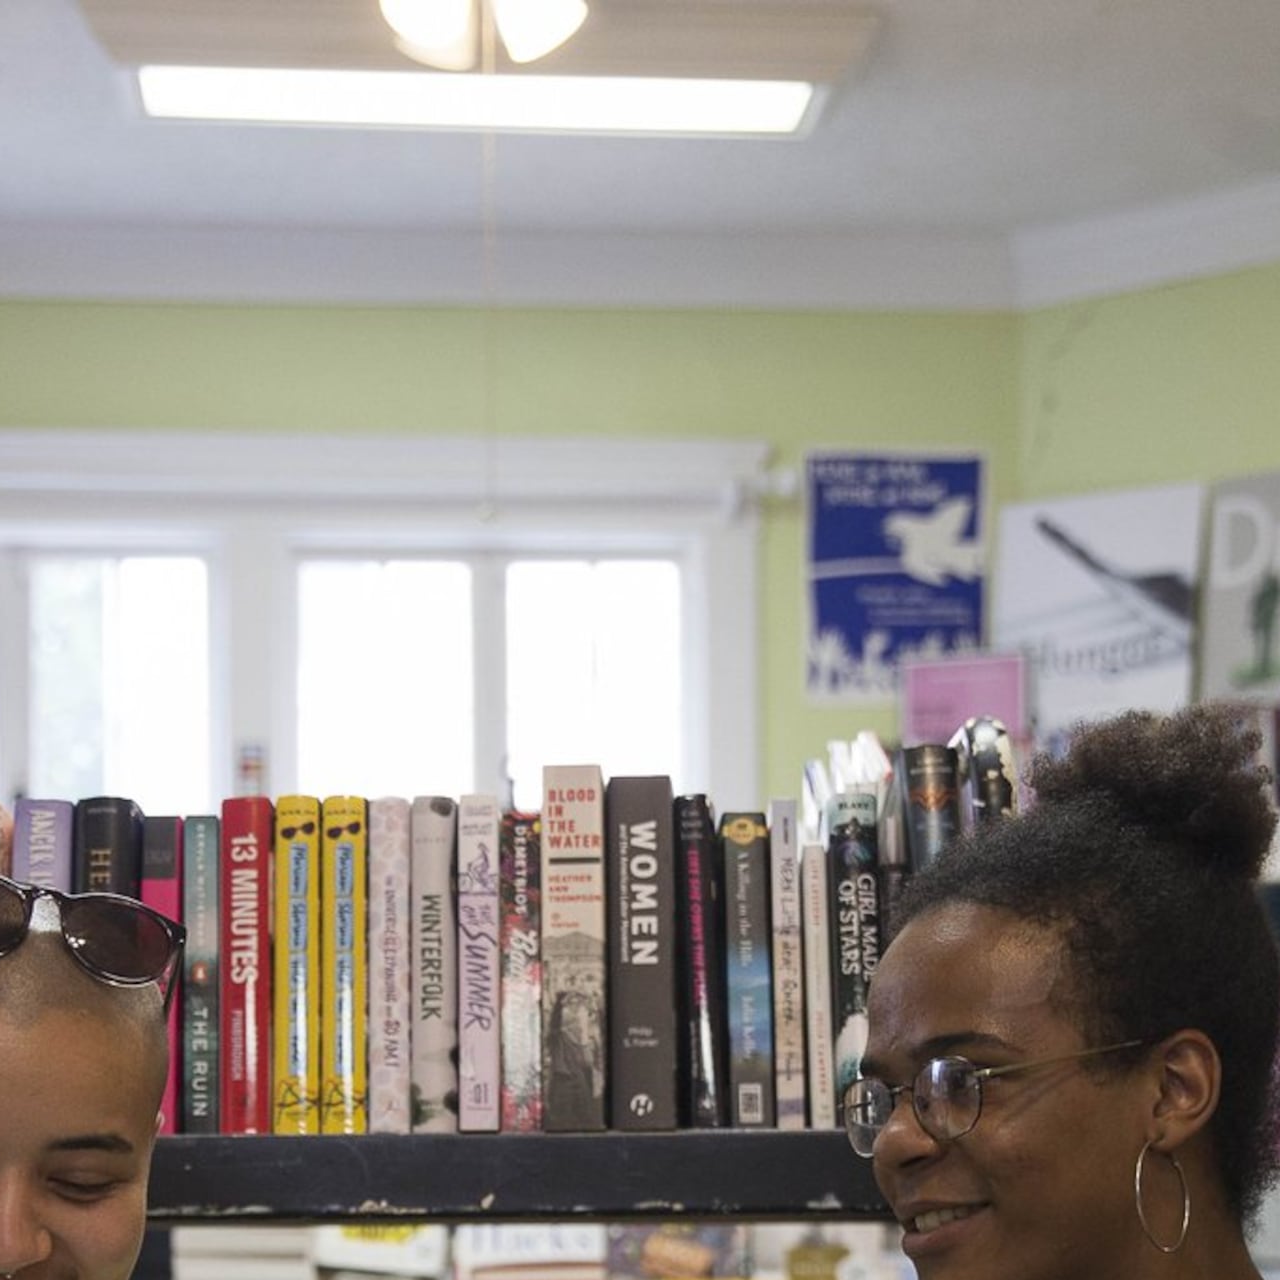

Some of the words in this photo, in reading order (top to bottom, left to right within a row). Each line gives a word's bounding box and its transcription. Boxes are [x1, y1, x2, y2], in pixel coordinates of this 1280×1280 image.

[547, 788, 596, 802] BLOOD
[548, 805, 563, 818] IN
[29, 809, 56, 866] ANGER
[548, 820, 576, 833] THE
[548, 835, 601, 848] WATER
[619, 824, 631, 840] and
[230, 833, 258, 863] 13
[619, 842, 630, 855] the
[514, 825, 528, 915] DEMETRIOS
[619, 857, 631, 896] American
[734, 863, 750, 900] Killing
[619, 897, 630, 919] Labor
[629, 820, 659, 965] WOMEN
[838, 881, 854, 904] OF
[857, 873, 876, 922] GIRL
[230, 868, 259, 985] MINUTES
[619, 920, 630, 963] Movement
[738, 918, 751, 936] the
[839, 909, 861, 976] STARS
[421, 894, 442, 1020] WINTERFOLK
[739, 940, 753, 967] Hills
[460, 922, 497, 1031] SUMMER
[741, 995, 754, 1023] Julia
[192, 1007, 209, 1051] THE
[192, 1060, 209, 1117] RUIN
